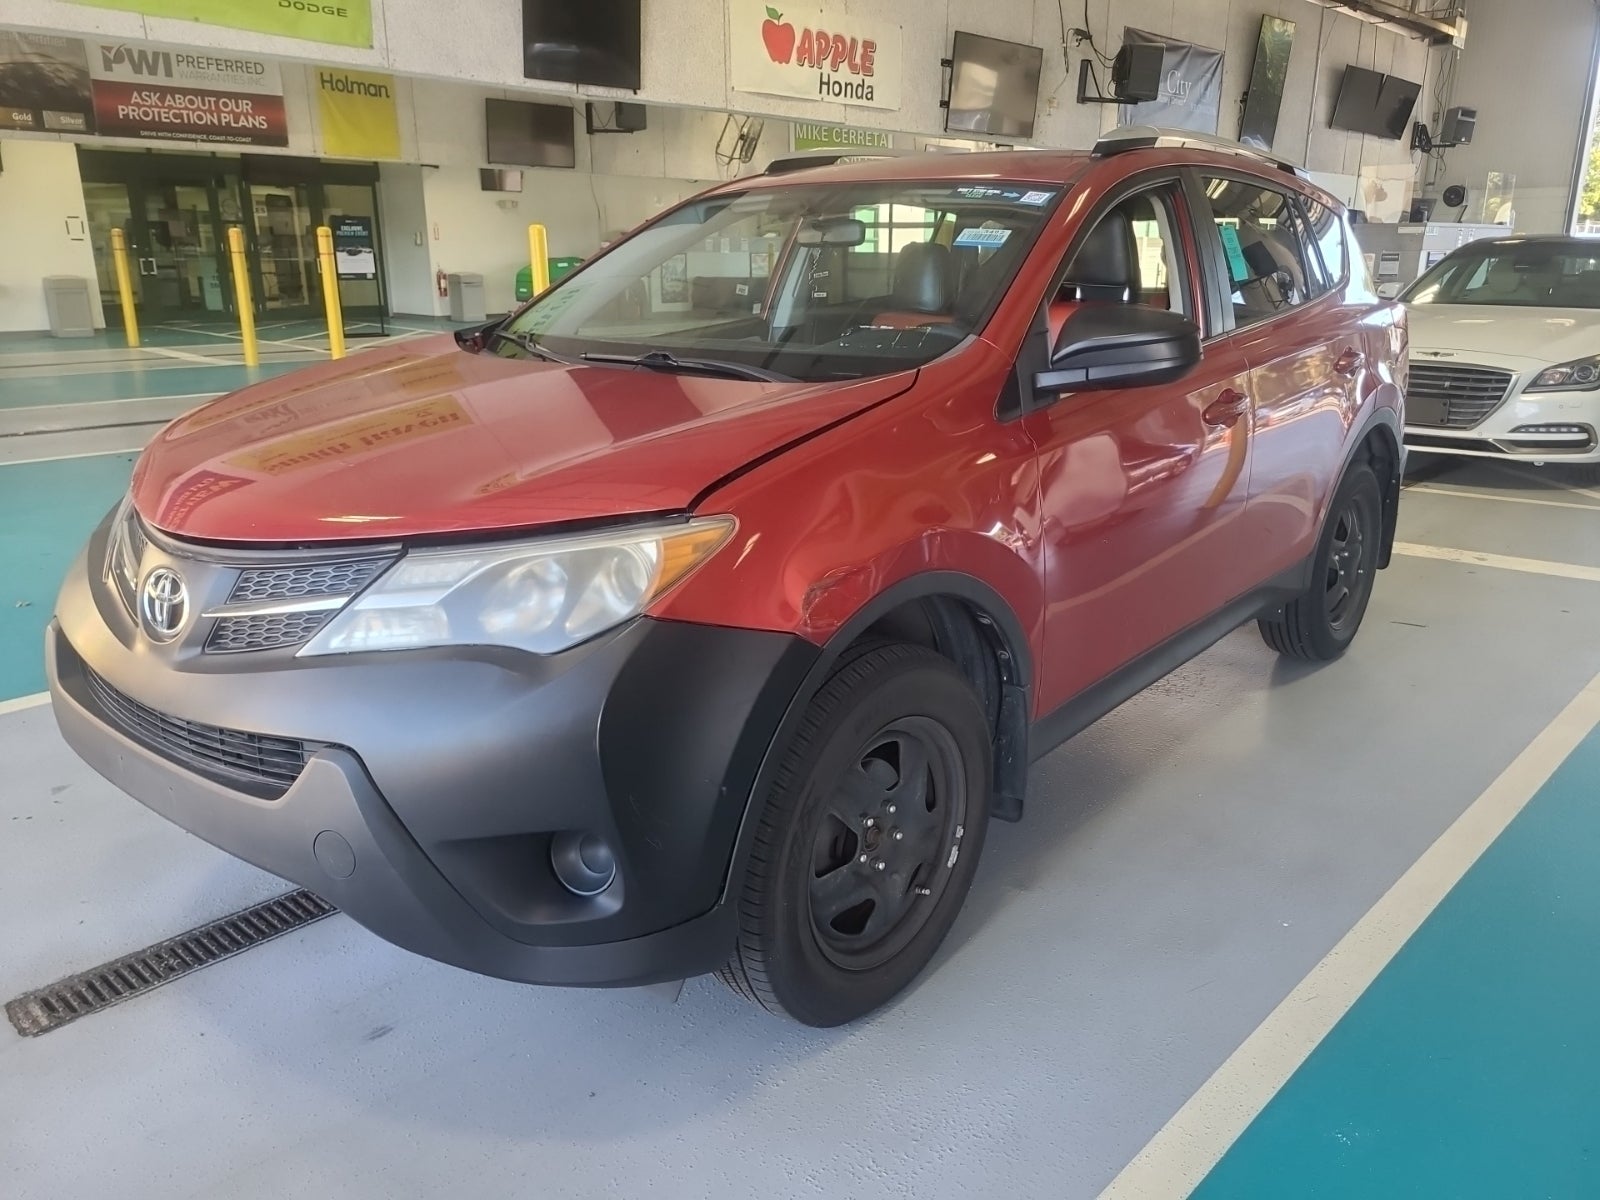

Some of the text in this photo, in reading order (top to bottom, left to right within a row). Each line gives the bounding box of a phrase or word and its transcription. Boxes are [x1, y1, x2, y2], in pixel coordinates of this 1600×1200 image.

[278, 0, 348, 17] DODGE
[99, 43, 174, 78] PWI
[796, 27, 877, 77] APPLE
[176, 54, 265, 75] PREFERRED
[320, 72, 390, 98] Holman
[819, 72, 874, 101] Honda
[1167, 69, 1192, 103] City
[130, 91, 253, 113] ASK ABOUT OUR
[12, 112, 32, 121] Gold
[60, 116, 83, 125] Silver
[118, 105, 268, 129] PROTECTION PLANS
[796, 123, 888, 148] MIKE CERRETA
